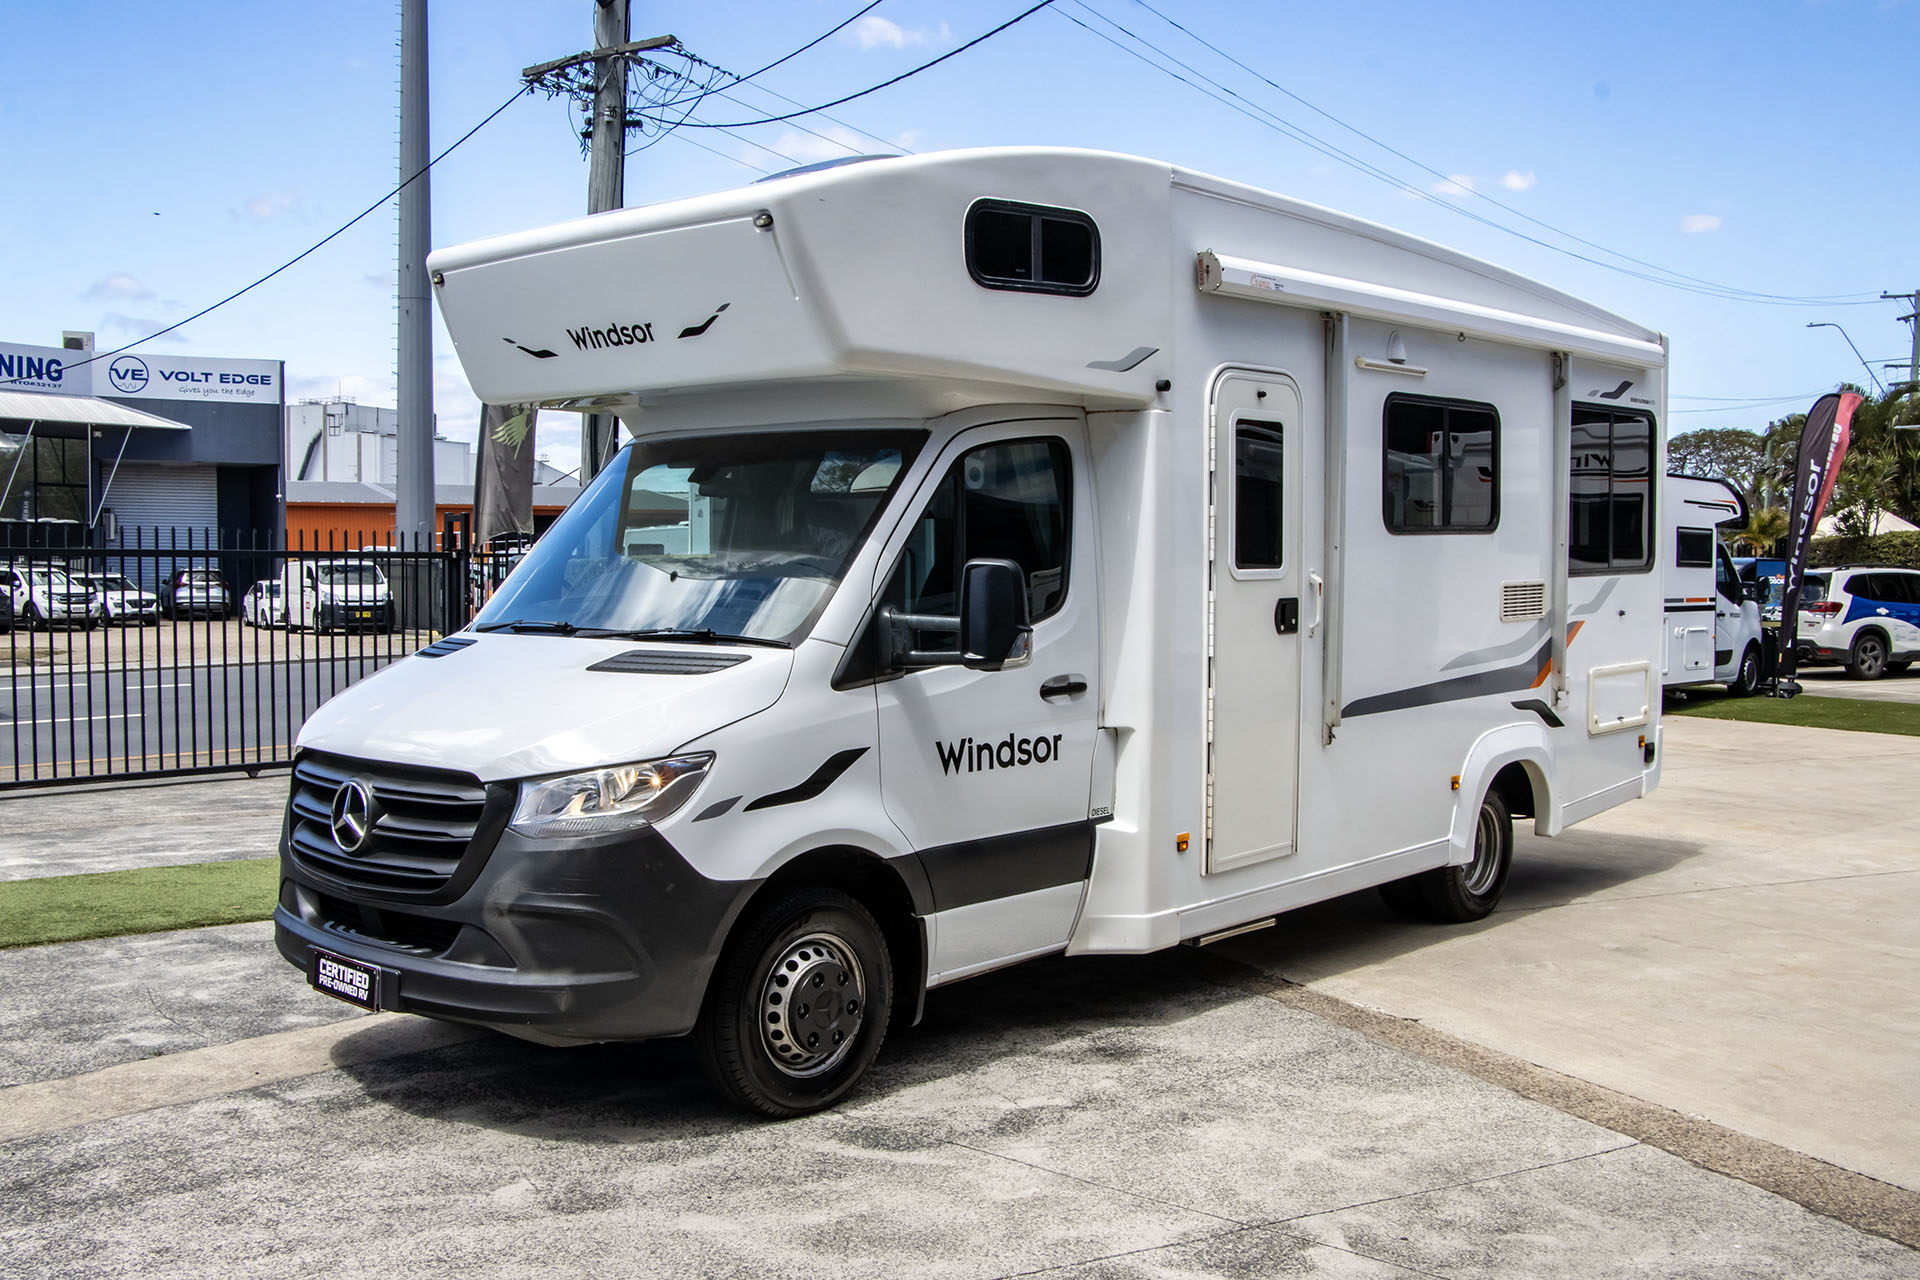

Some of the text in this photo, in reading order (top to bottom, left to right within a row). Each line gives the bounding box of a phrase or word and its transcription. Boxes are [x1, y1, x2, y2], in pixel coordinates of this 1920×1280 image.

[566, 322, 655, 351] Windsor
[0, 353, 63, 382] NING
[111, 368, 148, 380] VE
[159, 370, 272, 386] VOLT EDGE
[179, 386, 201, 394] Gives
[203, 387, 219, 397] you
[236, 388, 255, 398] Edge
[935, 733, 1063, 777] Windsor
[1091, 806, 1110, 817] DIESEL
[319, 958, 370, 990] CERTIFIED
[319, 974, 369, 1001] PRE-OWNED RV
